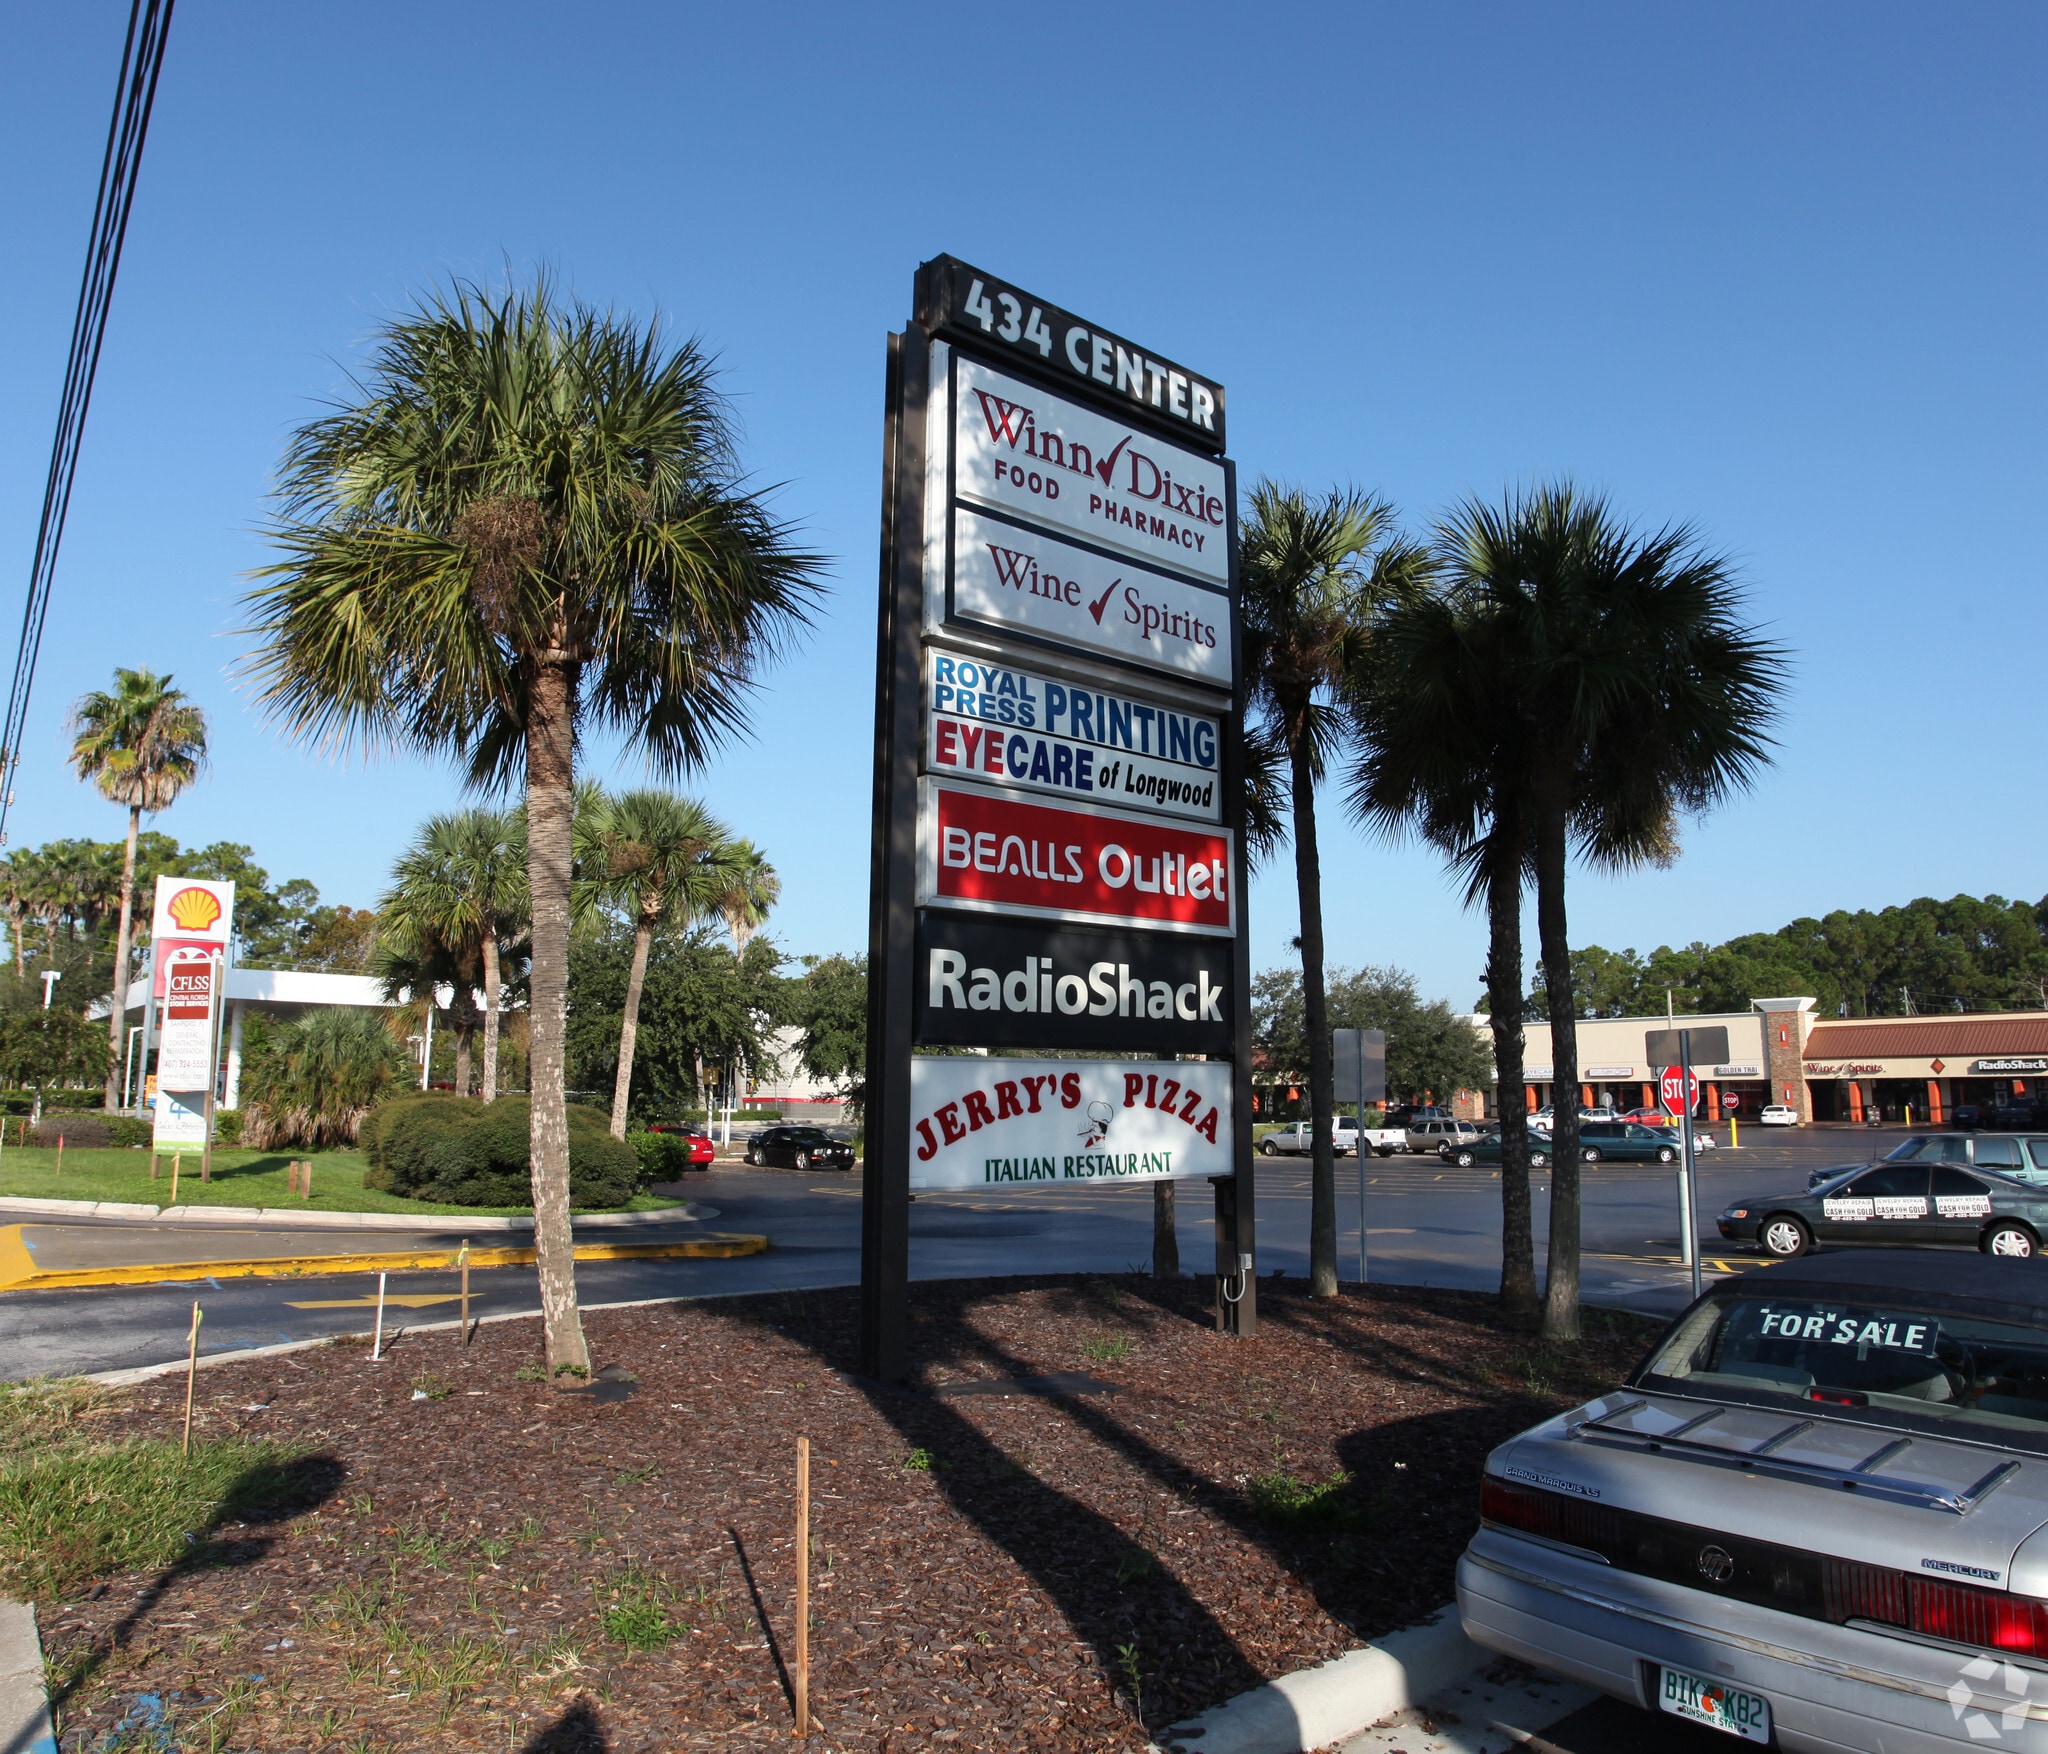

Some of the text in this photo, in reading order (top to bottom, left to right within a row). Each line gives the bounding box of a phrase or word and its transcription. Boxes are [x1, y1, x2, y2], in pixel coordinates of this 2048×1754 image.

[964, 278, 1216, 432] 434 CENTER
[972, 387, 1225, 528] Winn Dixie
[994, 459, 1206, 553] FOOD PHARMACY
[985, 543, 1217, 649] Wine Spirits
[935, 656, 1037, 703] ROYAL
[935, 683, 1036, 727] PRESS
[1045, 682, 1216, 768] PRINTING
[1099, 761, 1121, 789] of
[1124, 764, 1213, 808] Longwood
[942, 826, 1226, 901] BEALLS Outlet
[171, 975, 210, 990] CFLSS
[928, 947, 1224, 1022] RadioShack
[1718, 1066, 1742, 1074] GOLDEN
[1806, 1061, 1884, 1074] Wine Spirits
[1978, 1059, 2047, 1070] RadioShack
[915, 1072, 1218, 1162] JERRY'S PIZZA
[1723, 1096, 1738, 1104] STOP
[984, 1151, 1173, 1182] ITALIAN RESTAURANT
[1876, 1206, 1894, 1214] CASH
[1760, 1313, 1928, 1349] FOR SALE
[1505, 1466, 1537, 1481] GRAND
[1538, 1475, 1584, 1494] MARQUIS
[1586, 1487, 1600, 1498] LS
[1921, 1558, 2001, 1581] MERCURY
[1681, 1705, 1743, 1733] SUNSHINE STATE
[1724, 1688, 1763, 1729] K82
